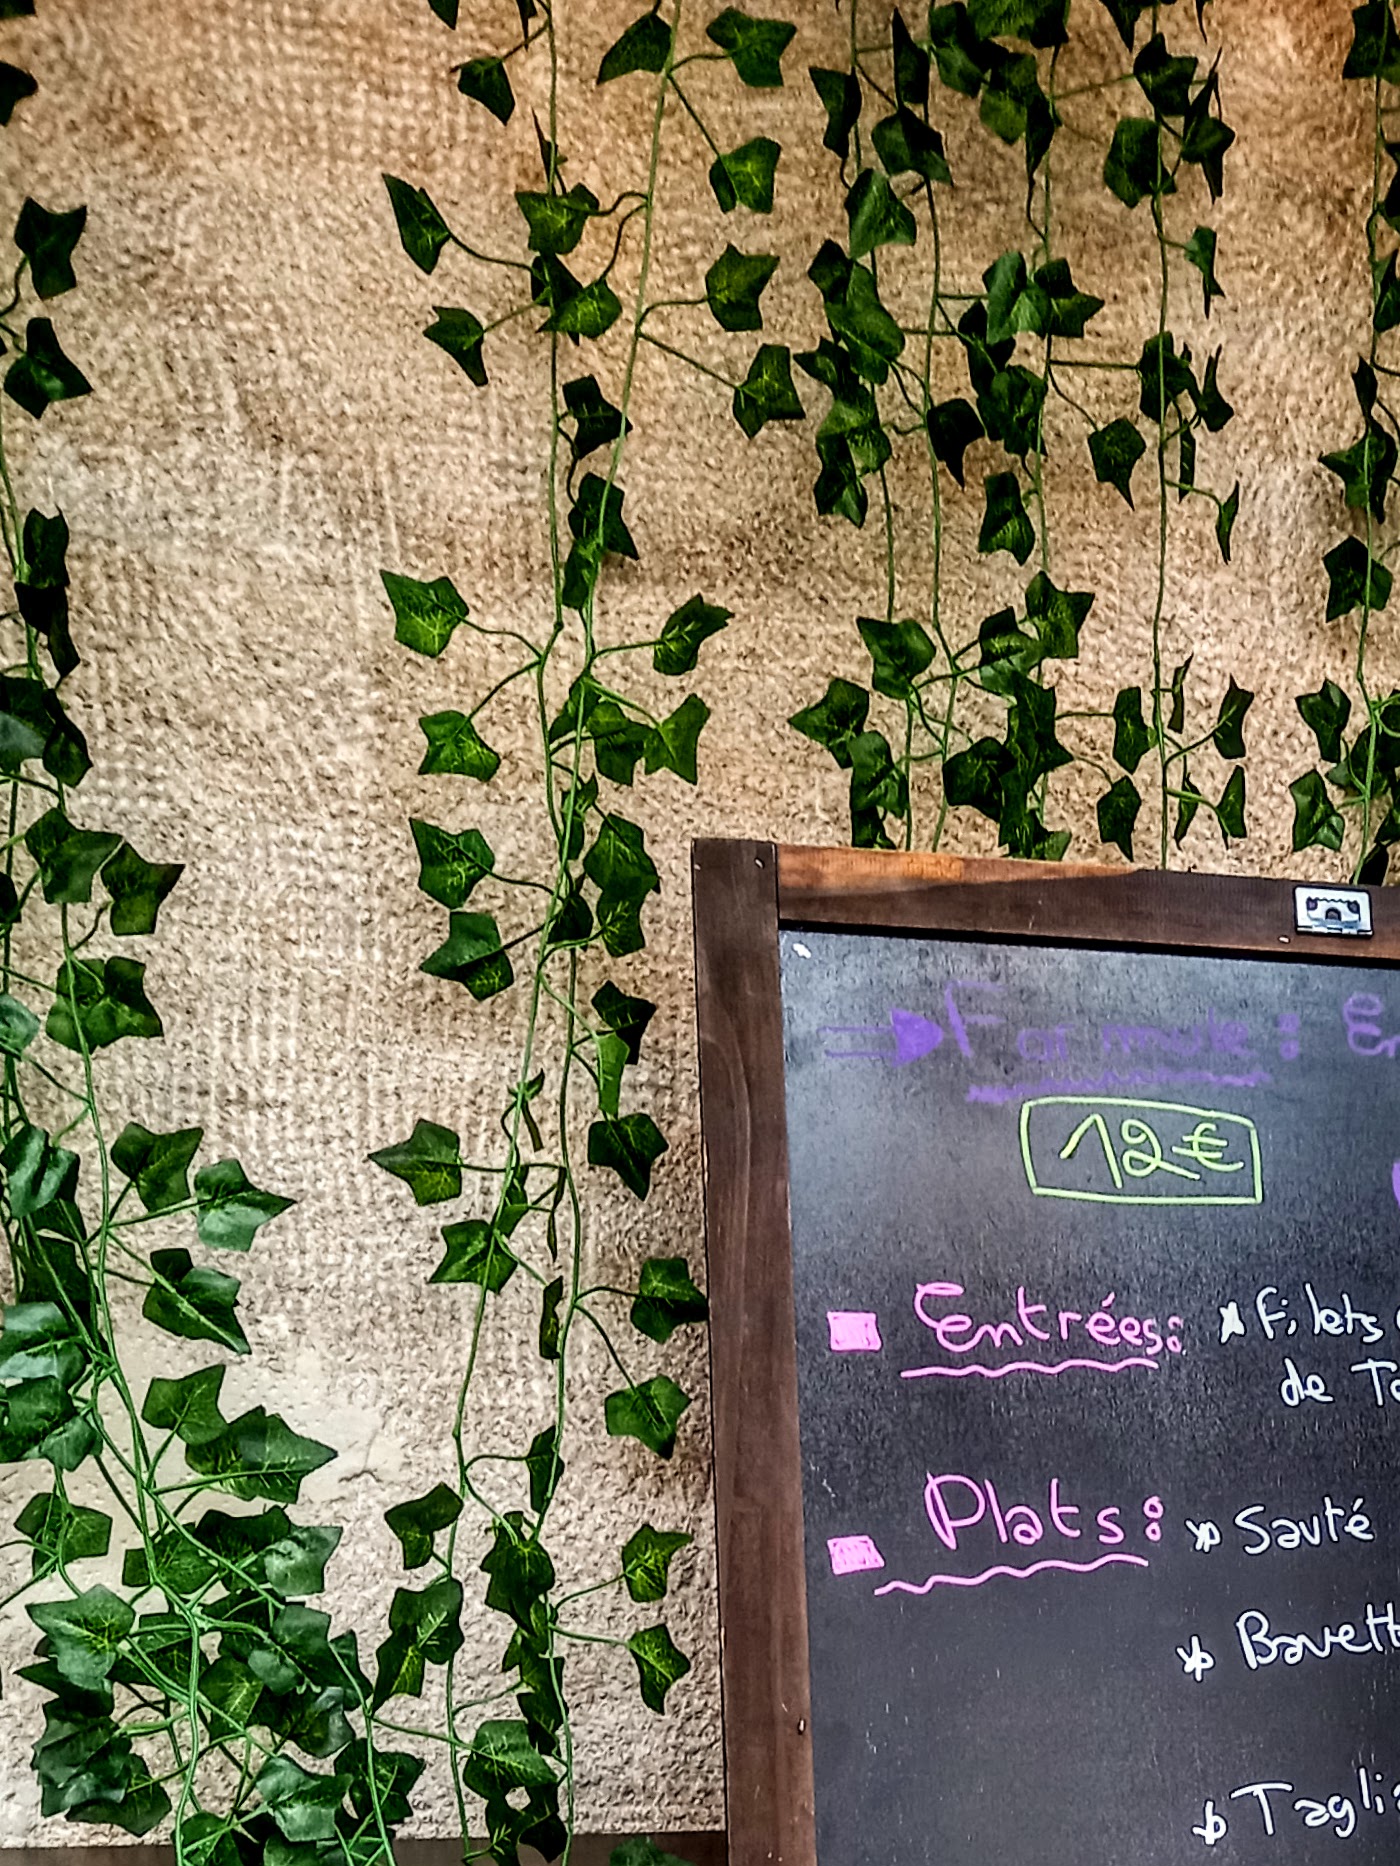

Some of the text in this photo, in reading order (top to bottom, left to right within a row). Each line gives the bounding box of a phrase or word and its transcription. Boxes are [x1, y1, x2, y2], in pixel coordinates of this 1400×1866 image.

[1060, 1113, 1245, 1189] 12€
[1280, 1357, 1334, 1406] de
[1234, 1496, 1374, 1554] Sauté
